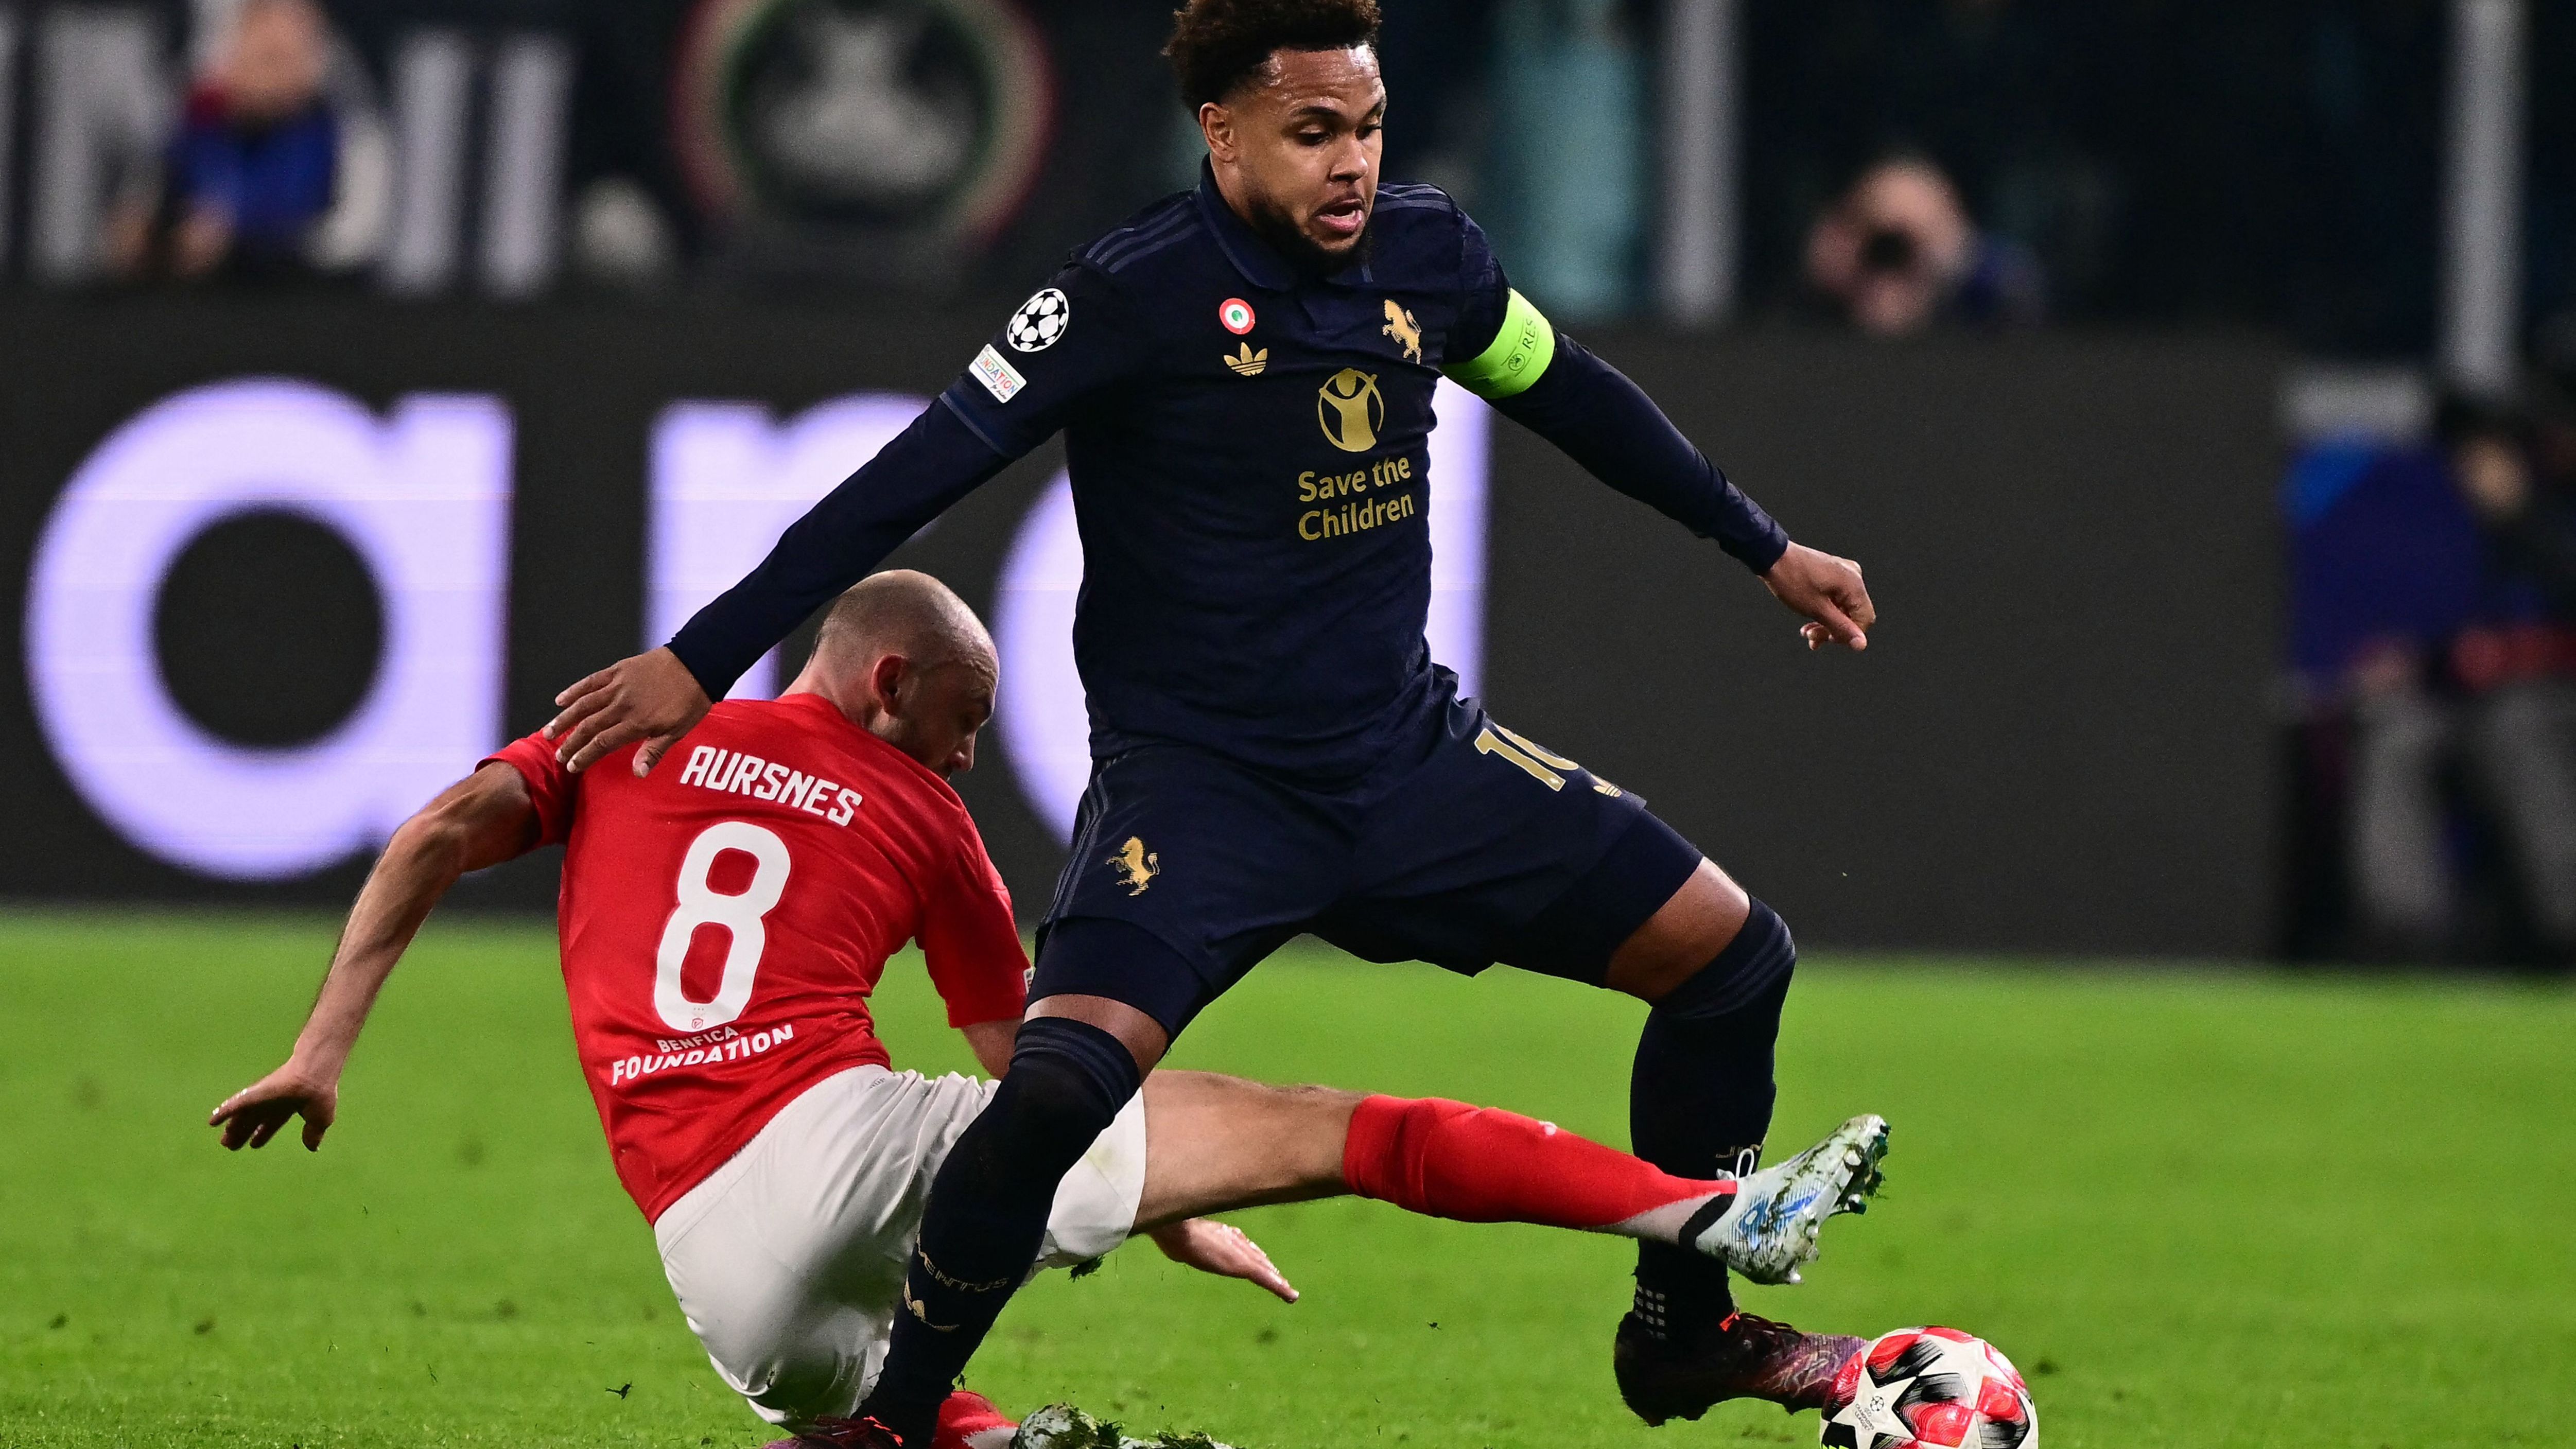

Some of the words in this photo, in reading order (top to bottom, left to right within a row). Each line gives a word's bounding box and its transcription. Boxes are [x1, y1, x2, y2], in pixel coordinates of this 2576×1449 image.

[978, 352, 1018, 394] UNDATION
[1298, 470, 1367, 502] Save
[1372, 457, 1412, 487] the
[1298, 494, 1415, 540] Children
[680, 745, 863, 826] AURSNES
[654, 821, 791, 1032] 8
[612, 1024, 794, 1086] FOUNDATION
[656, 1025, 739, 1053] BENFICA
